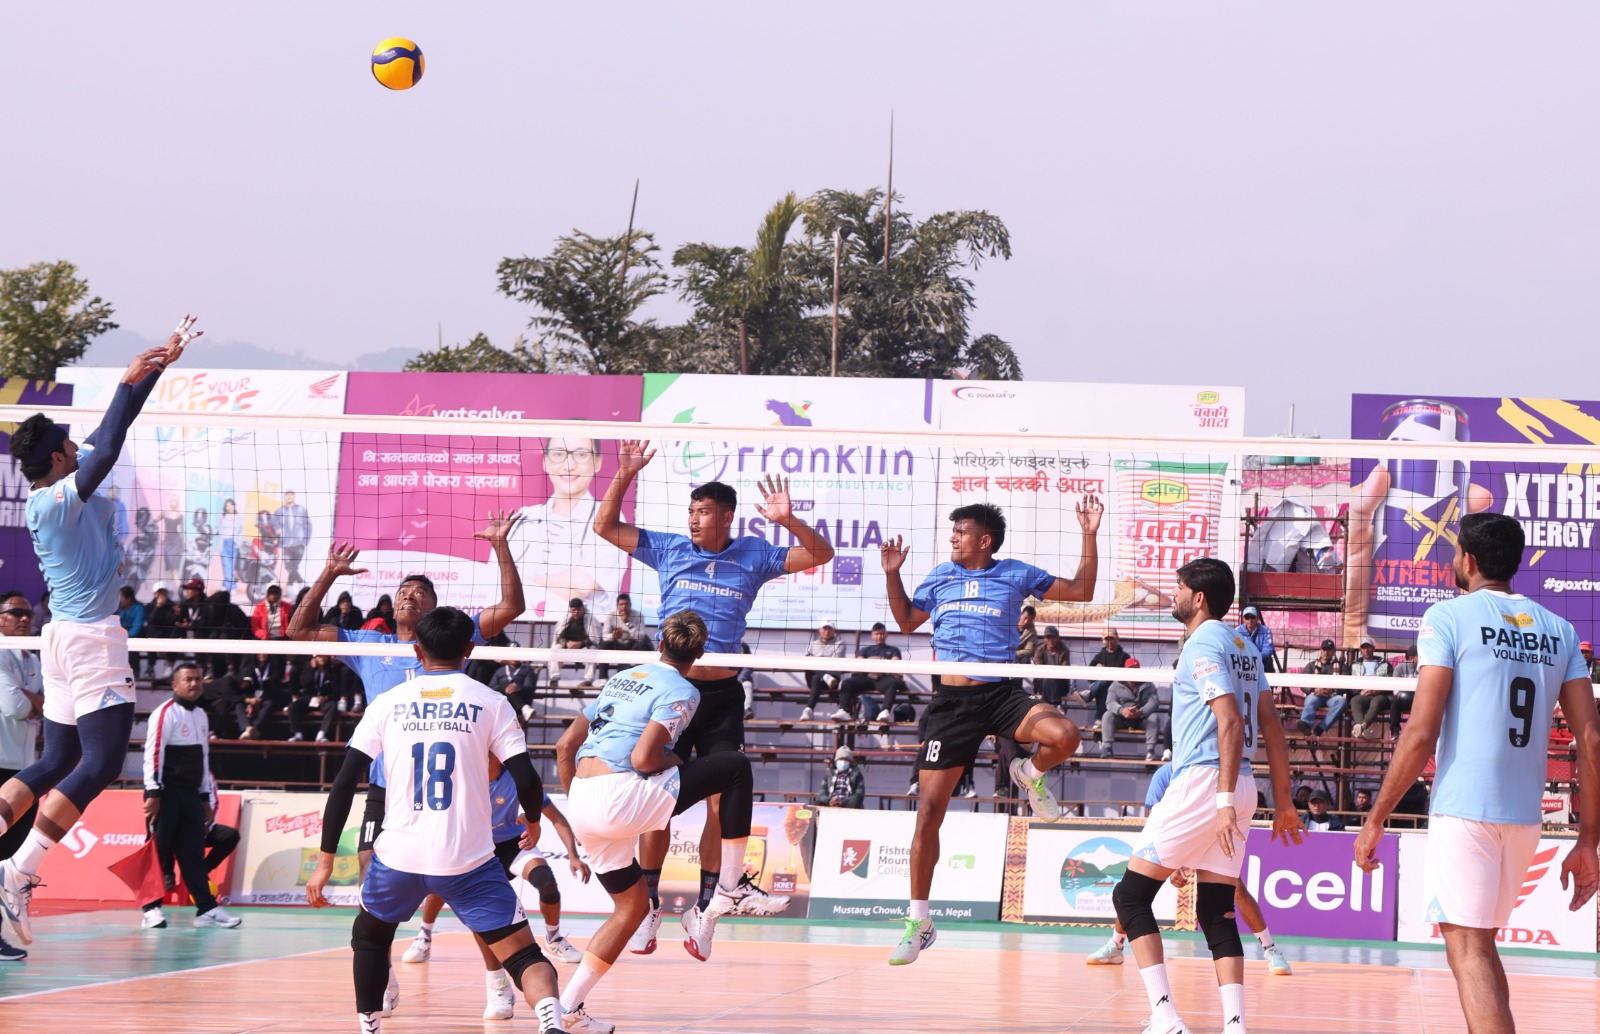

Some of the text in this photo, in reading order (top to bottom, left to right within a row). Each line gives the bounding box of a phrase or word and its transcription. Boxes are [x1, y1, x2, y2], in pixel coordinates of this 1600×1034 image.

[208, 377, 250, 397] YOUR
[1199, 418, 1229, 428] आटा
[358, 474, 379, 487] अब
[816, 480, 913, 492] CONSULTANCY
[1057, 477, 1105, 495] आटा
[379, 571, 403, 580] TIKA
[704, 562, 715, 579] 4
[964, 580, 979, 598] 18
[1377, 586, 1418, 597] ENERGY
[1421, 587, 1454, 599] DRINK
[1480, 626, 1560, 655] PARBAT
[1493, 648, 1554, 667] VOLLEYBALL
[608, 677, 653, 697] PARBAT
[394, 702, 483, 723] PARBAT
[1508, 676, 1536, 748] 9
[402, 721, 472, 733] VOLLEYBALL
[925, 740, 941, 762] 18
[411, 741, 456, 811] 18
[364, 821, 375, 842] 11
[102, 834, 146, 846] SUSHR
[879, 846, 910, 856] Fishta
[878, 856, 910, 866] Moun
[877, 866, 910, 878] Colleg
[773, 881, 794, 889] HONEY
[833, 905, 870, 916] Mustang
[873, 905, 904, 916] Chowk,
[946, 908, 972, 918] Nepal
